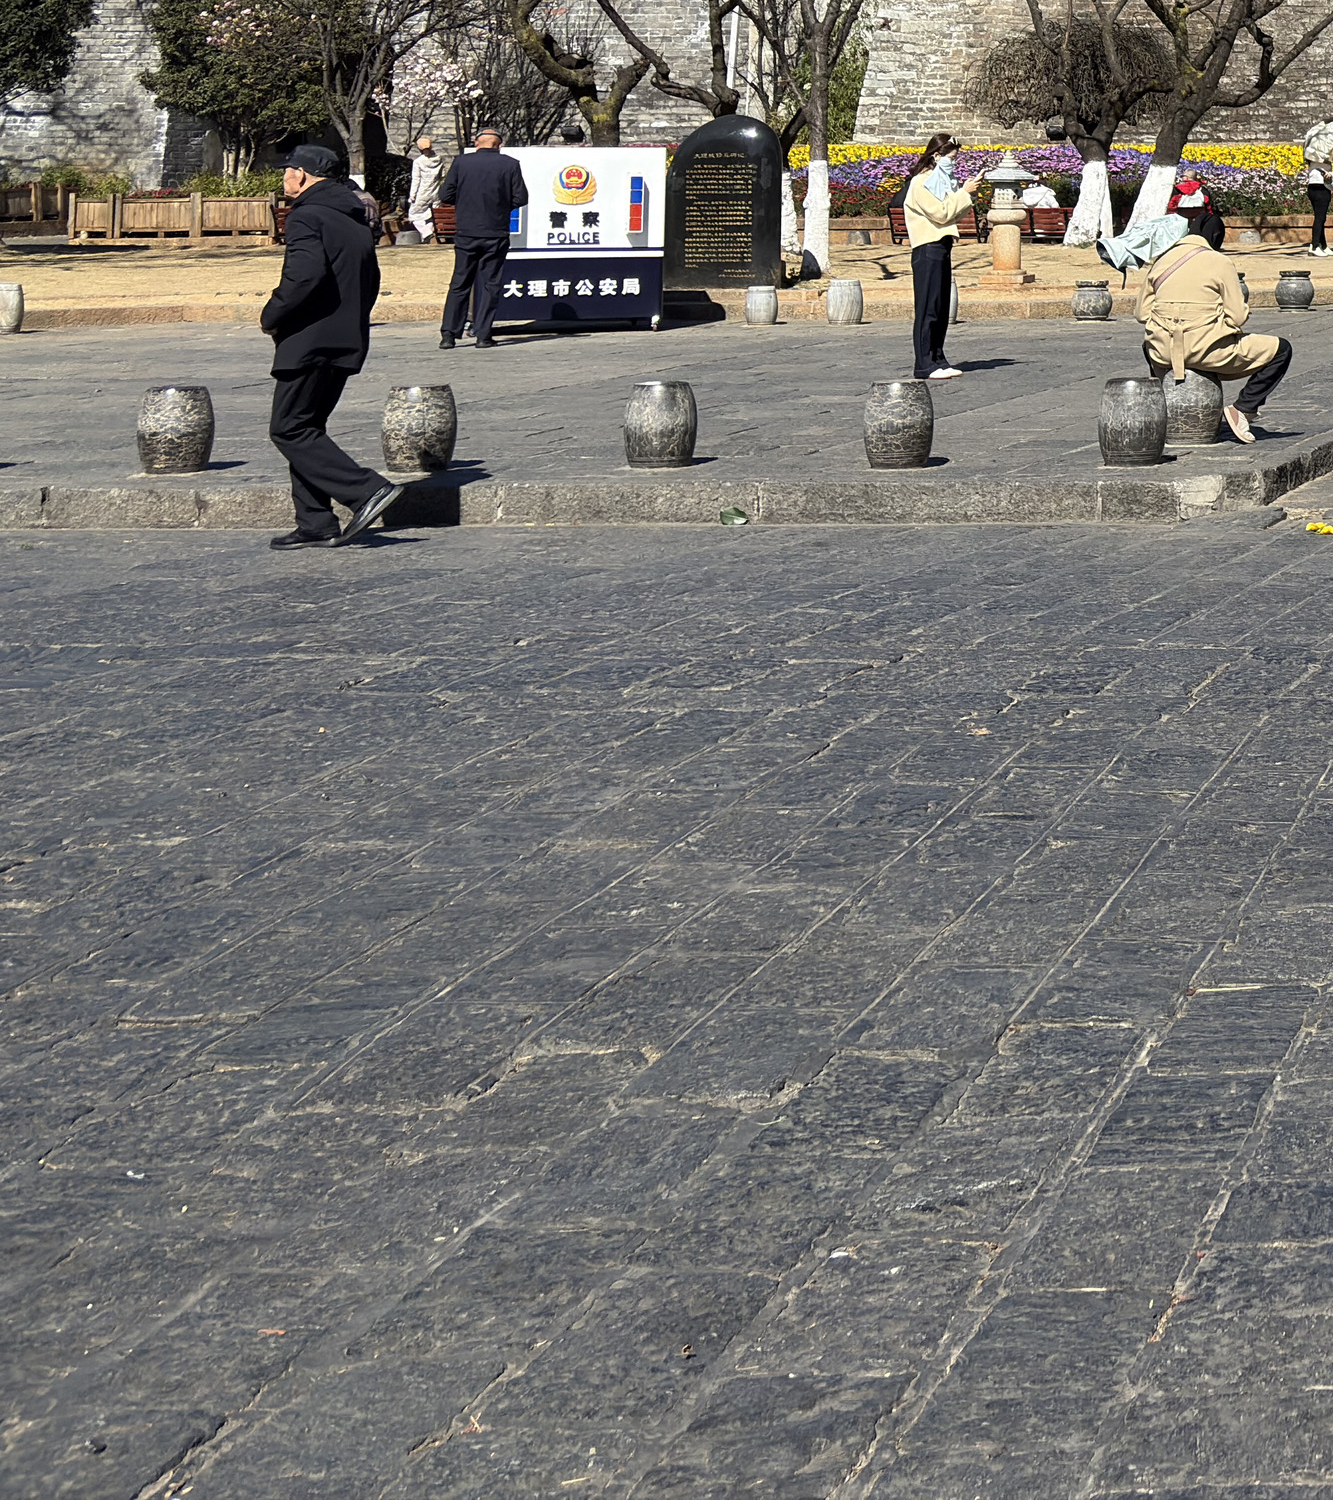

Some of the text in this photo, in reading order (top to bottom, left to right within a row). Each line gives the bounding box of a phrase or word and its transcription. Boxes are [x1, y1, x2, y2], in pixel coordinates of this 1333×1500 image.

[549, 211, 600, 228] 警察
[547, 232, 600, 244] POLICE
[503, 278, 641, 298] 大理市公安局
